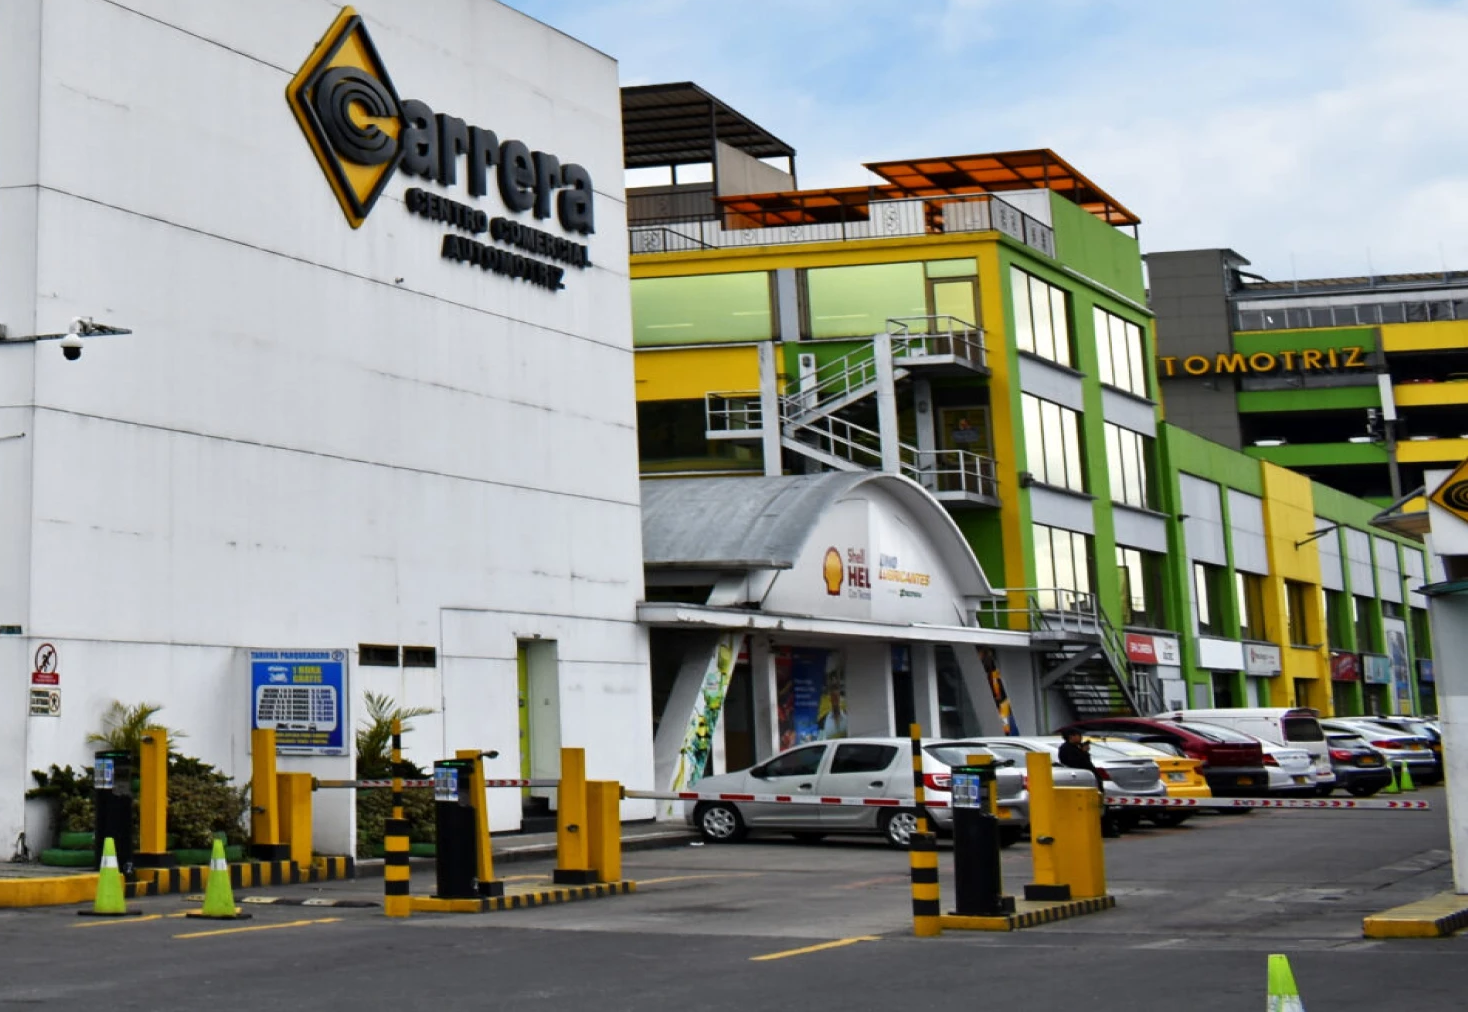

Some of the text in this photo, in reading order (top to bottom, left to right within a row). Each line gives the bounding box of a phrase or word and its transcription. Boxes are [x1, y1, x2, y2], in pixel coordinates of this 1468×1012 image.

[312, 66, 595, 235] Carrera
[405, 187, 593, 268] CENTRO COMERCIAL
[847, 547, 865, 565] Shell
